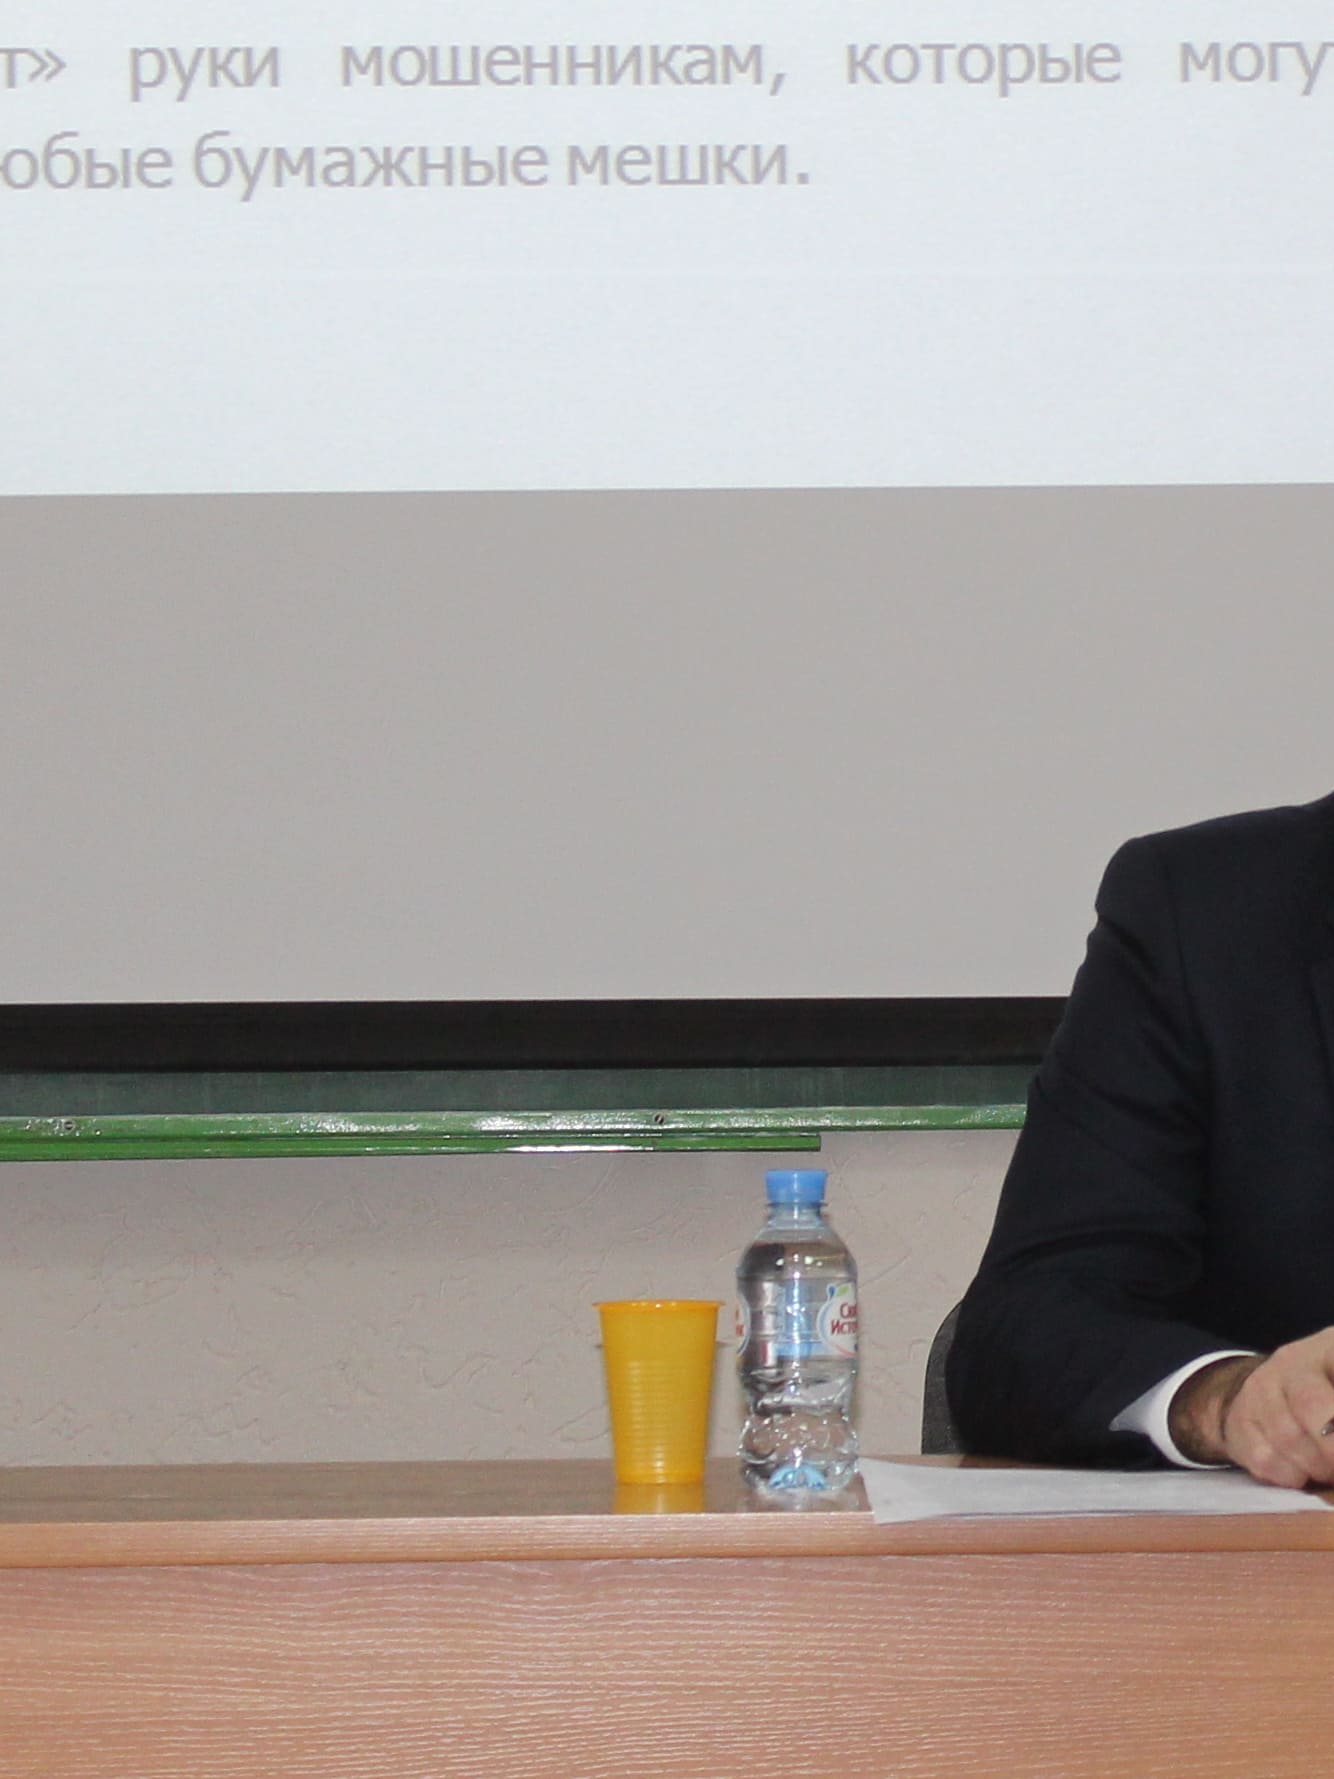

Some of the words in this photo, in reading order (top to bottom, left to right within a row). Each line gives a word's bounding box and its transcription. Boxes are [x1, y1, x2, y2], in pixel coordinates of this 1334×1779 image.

[130, 46, 281, 103] руки
[341, 43, 787, 97] мошенникам,
[846, 42, 1123, 98] которые
[191, 129, 550, 203] бумажные
[567, 143, 811, 187] мешки.
